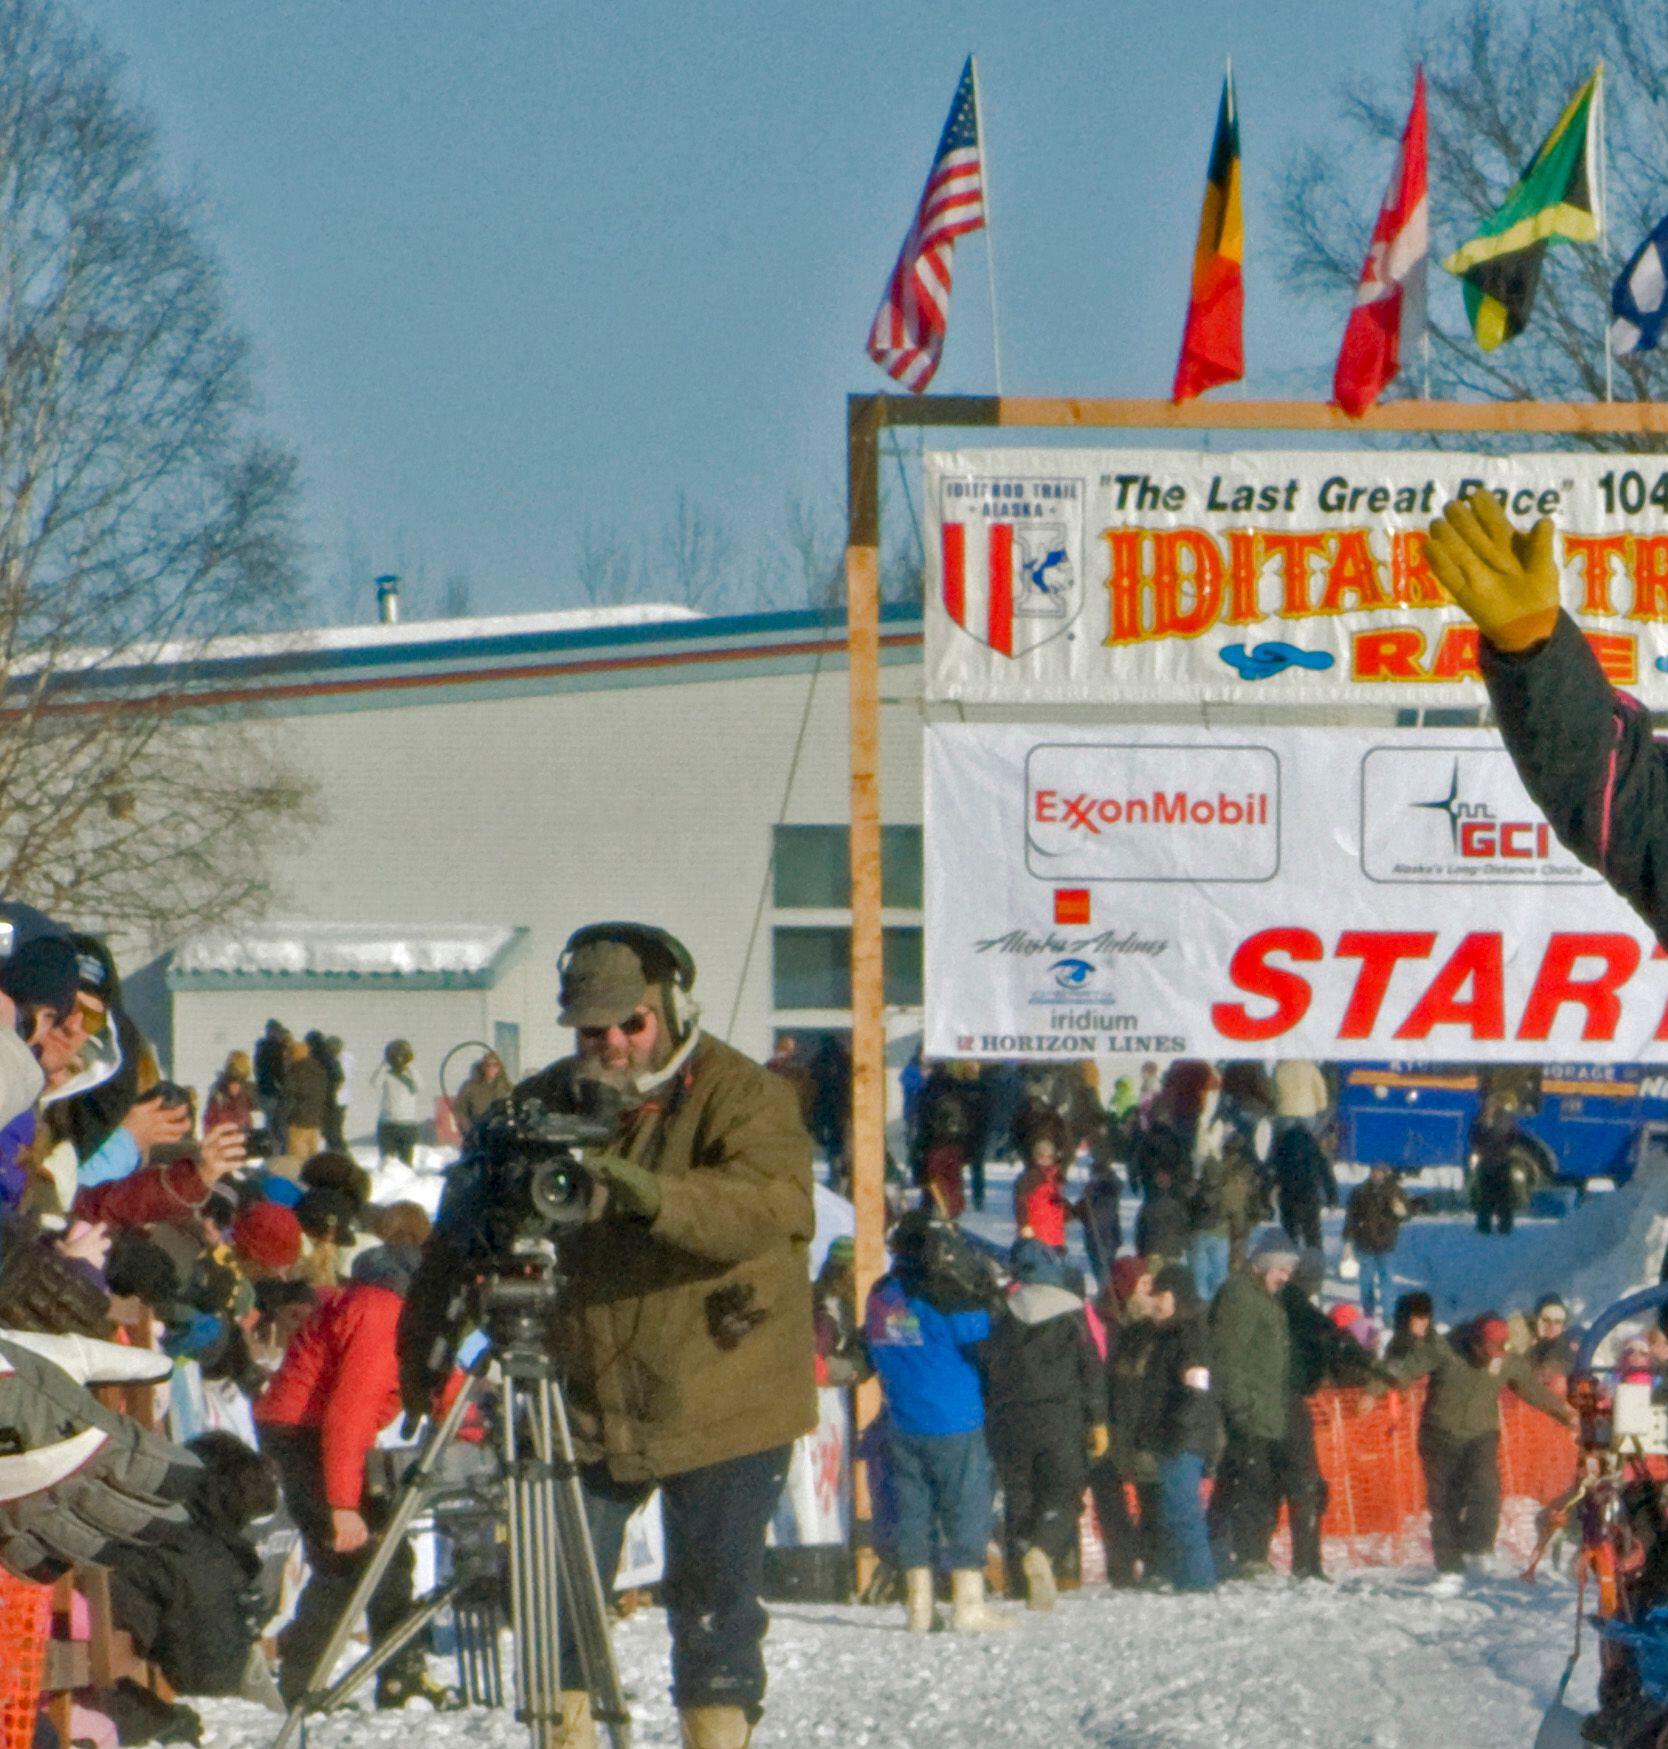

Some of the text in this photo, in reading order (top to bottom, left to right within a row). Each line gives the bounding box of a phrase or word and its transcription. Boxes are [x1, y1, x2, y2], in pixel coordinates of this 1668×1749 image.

[1033, 482, 1076, 498] TRAIL
[1206, 475, 1299, 513] Last
[1318, 475, 1436, 514] Great
[982, 502, 1043, 517] ALASKA
[1100, 525, 1461, 648] IDITAR
[1351, 621, 1638, 685] RAE
[1035, 789, 1268, 835] ExxonMobil
[1461, 822, 1549, 858] GCI
[1051, 1008, 1138, 1031] iridium
[982, 1035, 1187, 1052] HORIZON LINES
